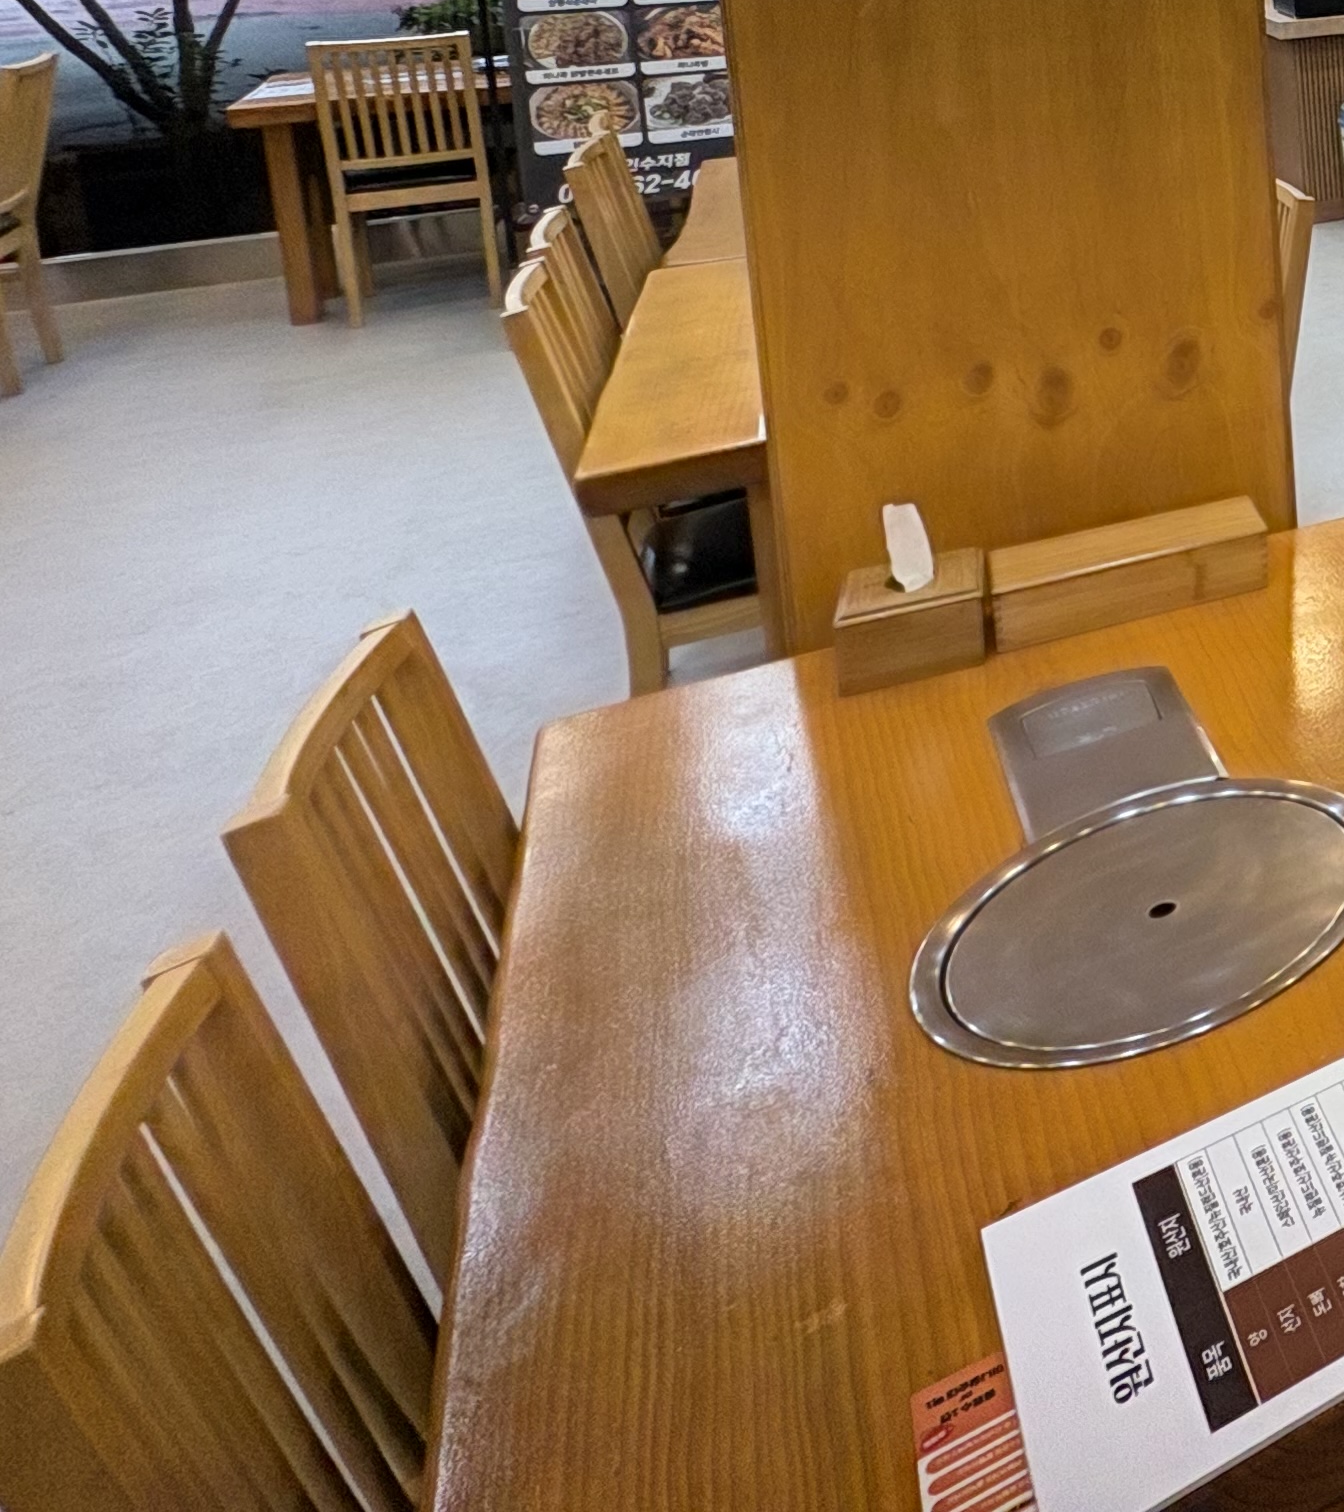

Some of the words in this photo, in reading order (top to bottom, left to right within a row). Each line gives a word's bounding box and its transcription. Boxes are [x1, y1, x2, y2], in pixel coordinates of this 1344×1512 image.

[1232, 1185, 1254, 1216] 국내산
[1157, 1213, 1191, 1259] 원산지
[1080, 1252, 1154, 1404] 원산지표시
[1277, 1304, 1302, 1334] 선지
[1247, 1329, 1268, 1347] 양
[1201, 1340, 1233, 1381] 품목
